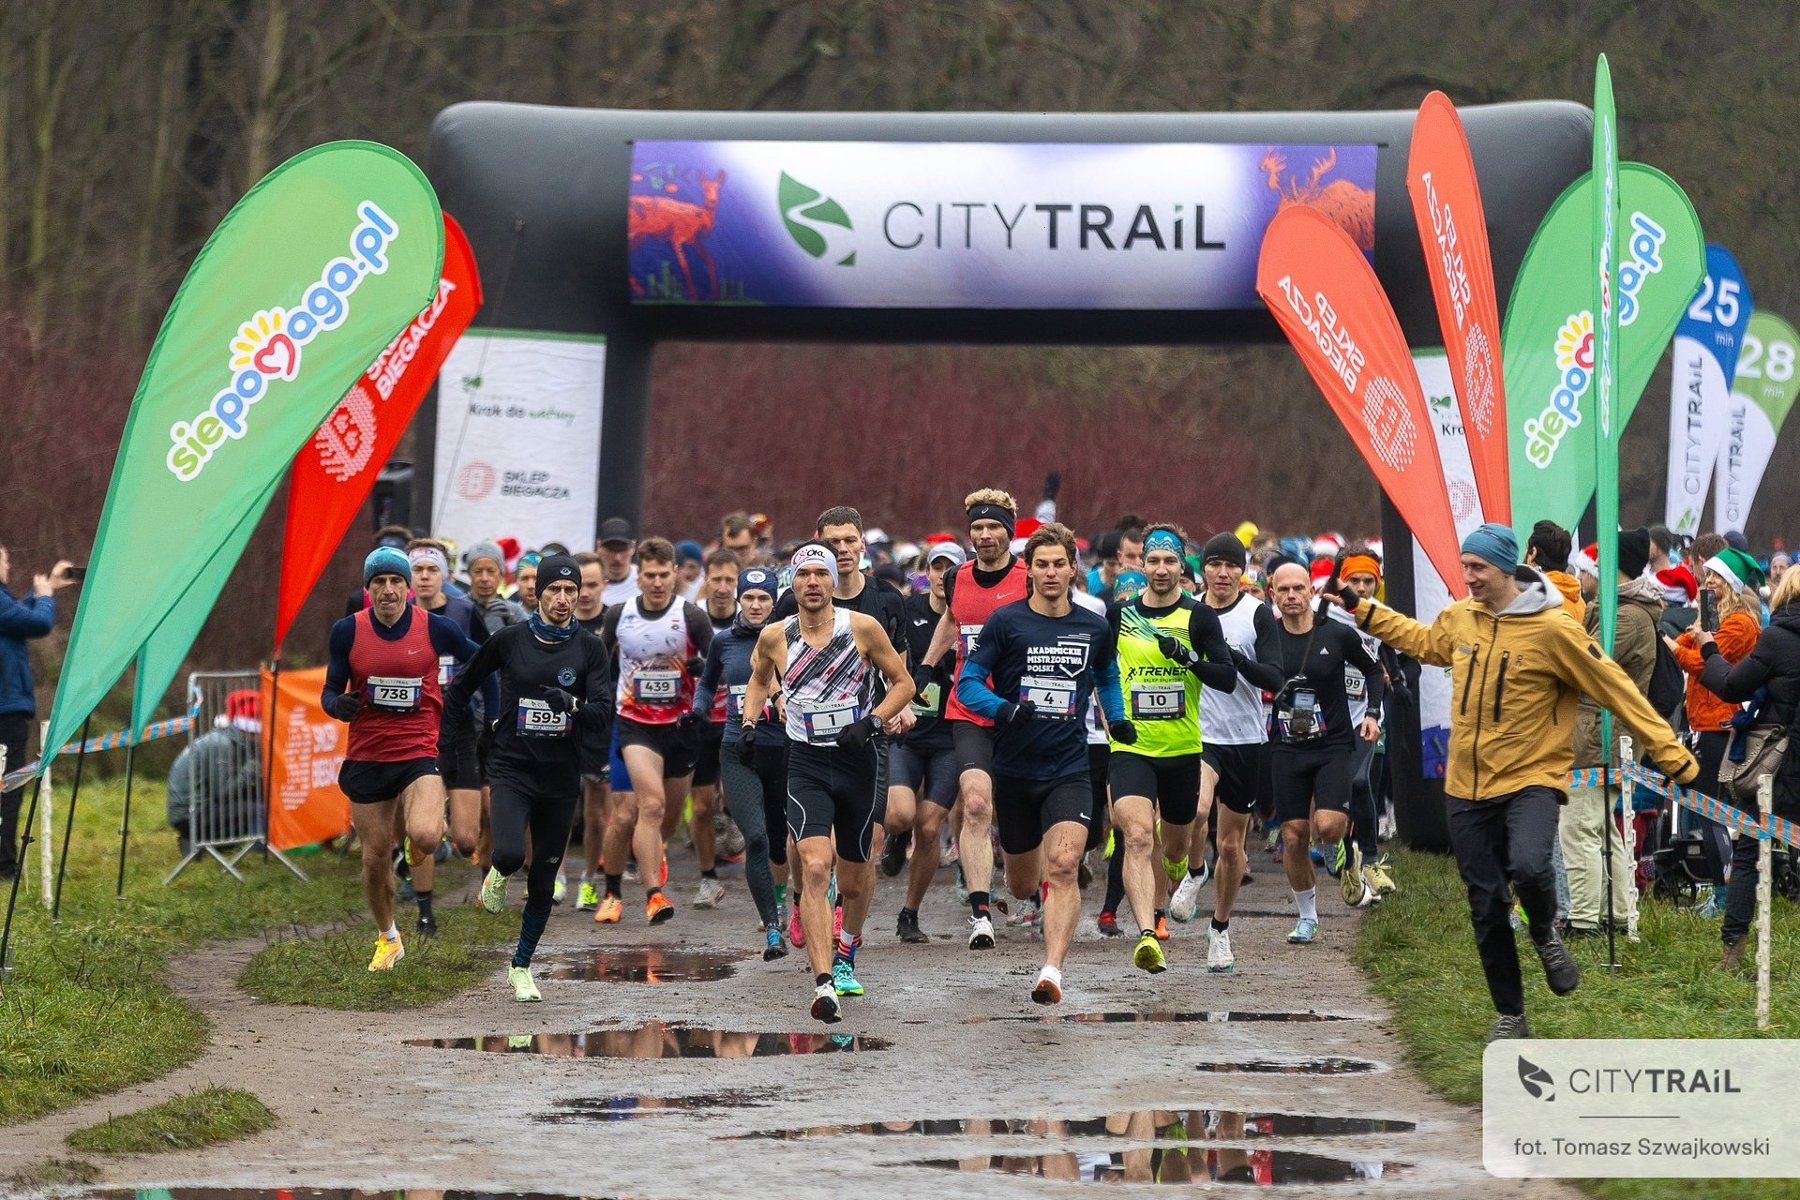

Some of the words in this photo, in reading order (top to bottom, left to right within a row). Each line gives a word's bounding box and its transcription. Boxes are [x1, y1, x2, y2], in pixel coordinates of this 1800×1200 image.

[1688, 274, 1741, 328] 25
[1715, 330, 1735, 348] min
[1735, 334, 1795, 383] 28
[1763, 382, 1785, 399] min
[503, 470, 550, 483] SKLEP
[501, 484, 571, 499] BIEGACZA
[1027, 646, 1082, 656] AKADEMICKIE
[1027, 656, 1083, 665] MISTRZOSTWA
[645, 681, 670, 692] 439
[380, 688, 409, 700] 738
[1044, 691, 1055, 705] 4
[1148, 694, 1167, 706] 10
[531, 711, 562, 724] 595
[828, 713, 836, 726] 1
